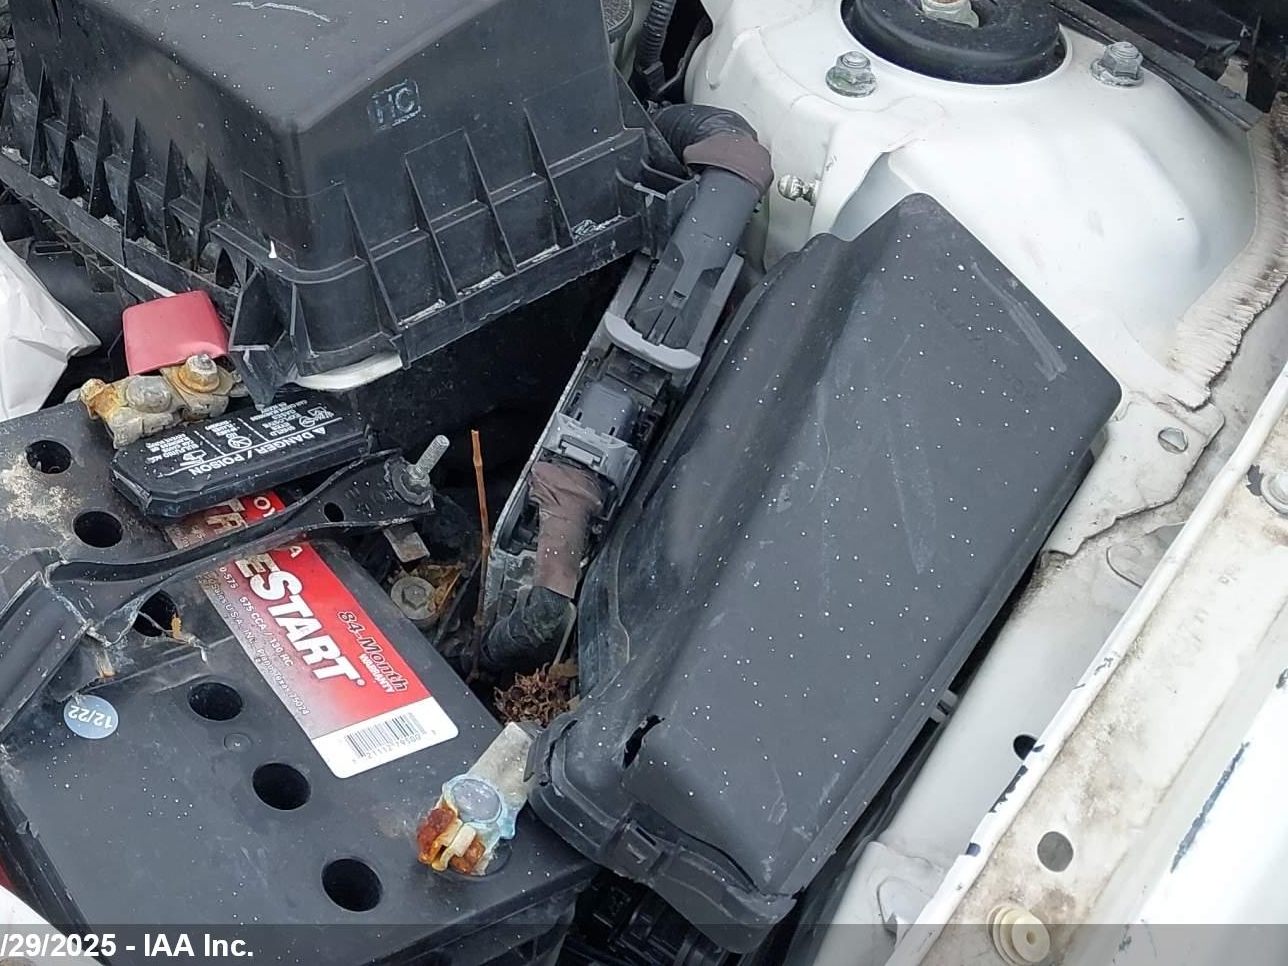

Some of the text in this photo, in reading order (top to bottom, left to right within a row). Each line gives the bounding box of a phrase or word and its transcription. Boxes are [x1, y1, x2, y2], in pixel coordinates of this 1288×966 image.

[256, 431, 316, 455] DANGER
[189, 453, 247, 476] POISON
[239, 596, 253, 612] 575
[250, 610, 267, 632] CCA
[280, 652, 295, 667] RC
[337, 611, 409, 693] 84-Month
[359, 653, 395, 694] WARRANTY
[288, 691, 311, 715] 75024
[68, 705, 113, 729] 12/22
